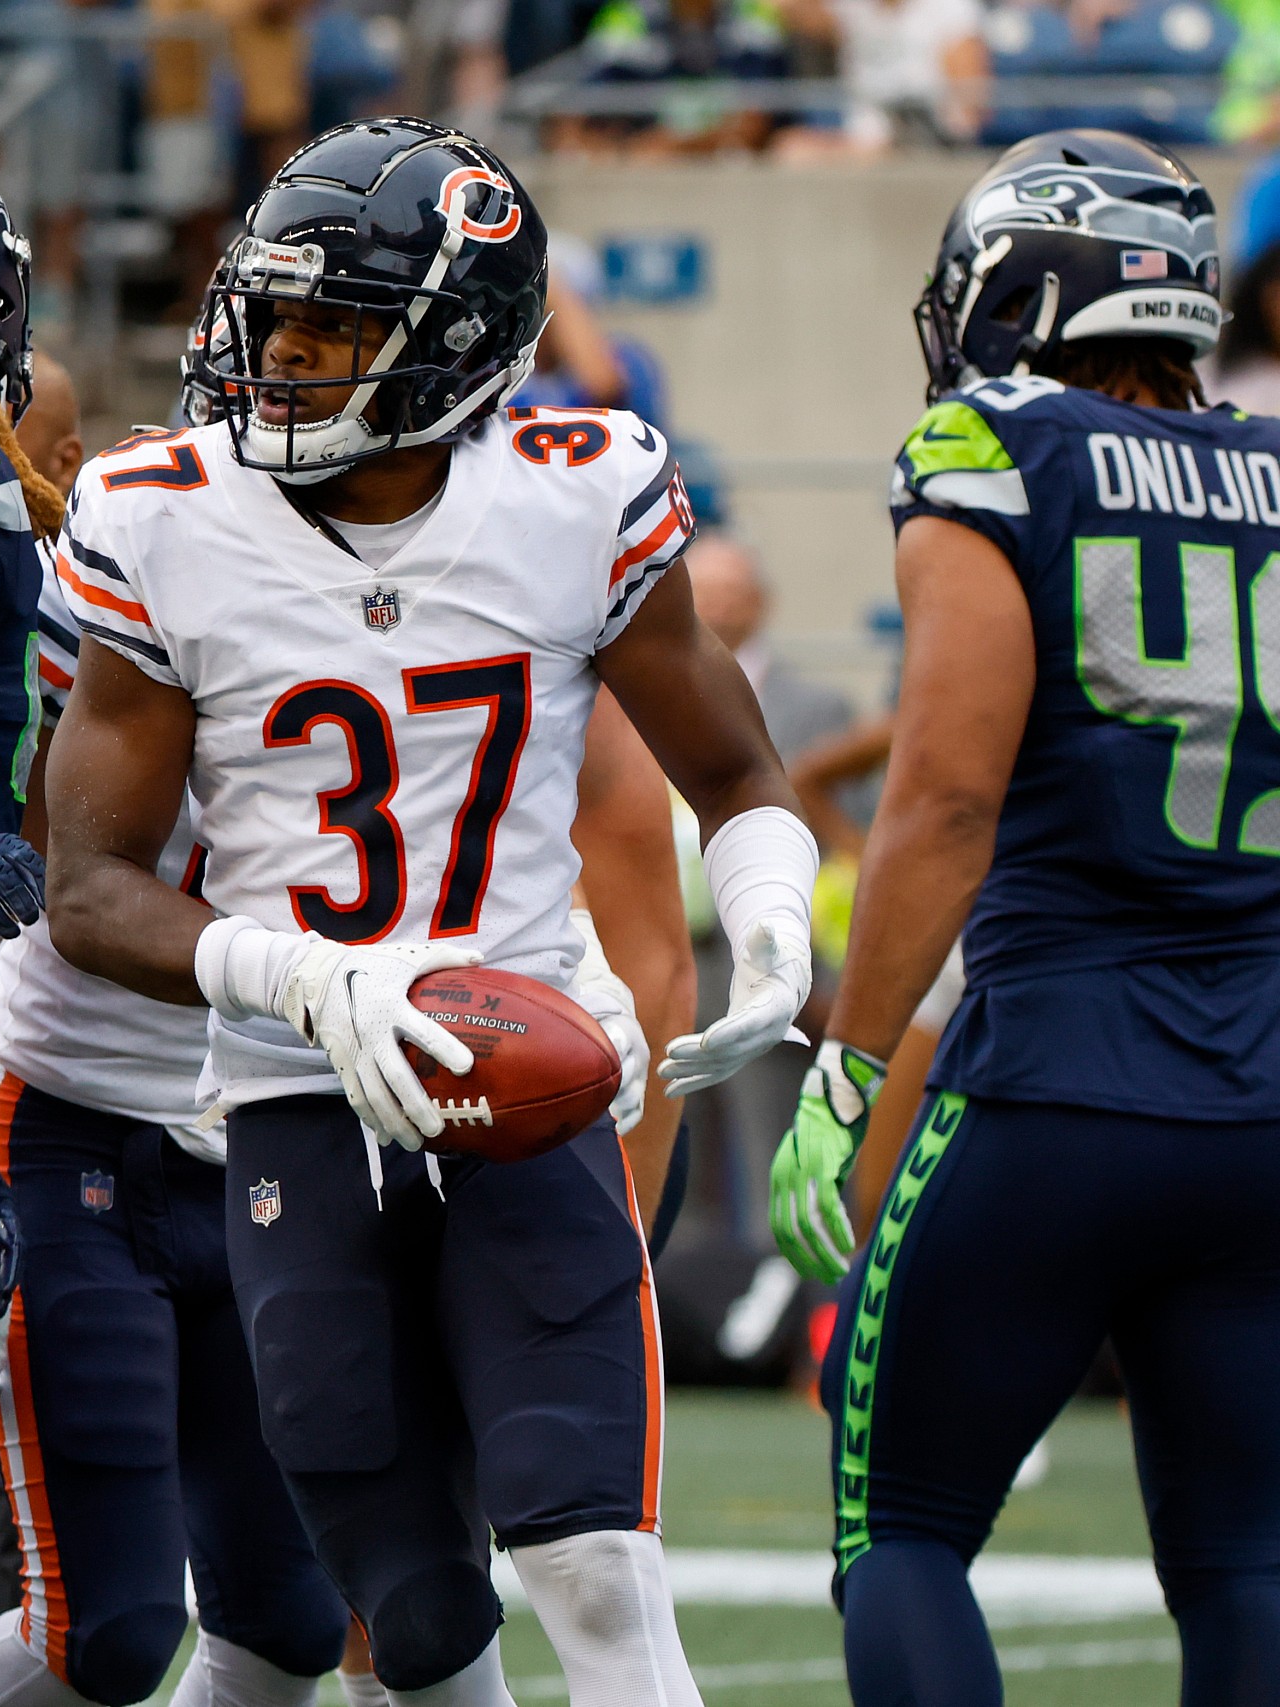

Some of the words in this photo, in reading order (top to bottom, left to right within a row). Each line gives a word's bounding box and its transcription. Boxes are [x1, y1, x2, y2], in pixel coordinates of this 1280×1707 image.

[1132, 302, 1171, 319] END
[368, 606, 396, 625] NFL
[262, 652, 531, 945] 37
[464, 1014, 526, 1034] NATIONAL
[255, 1199, 276, 1217] NFL
